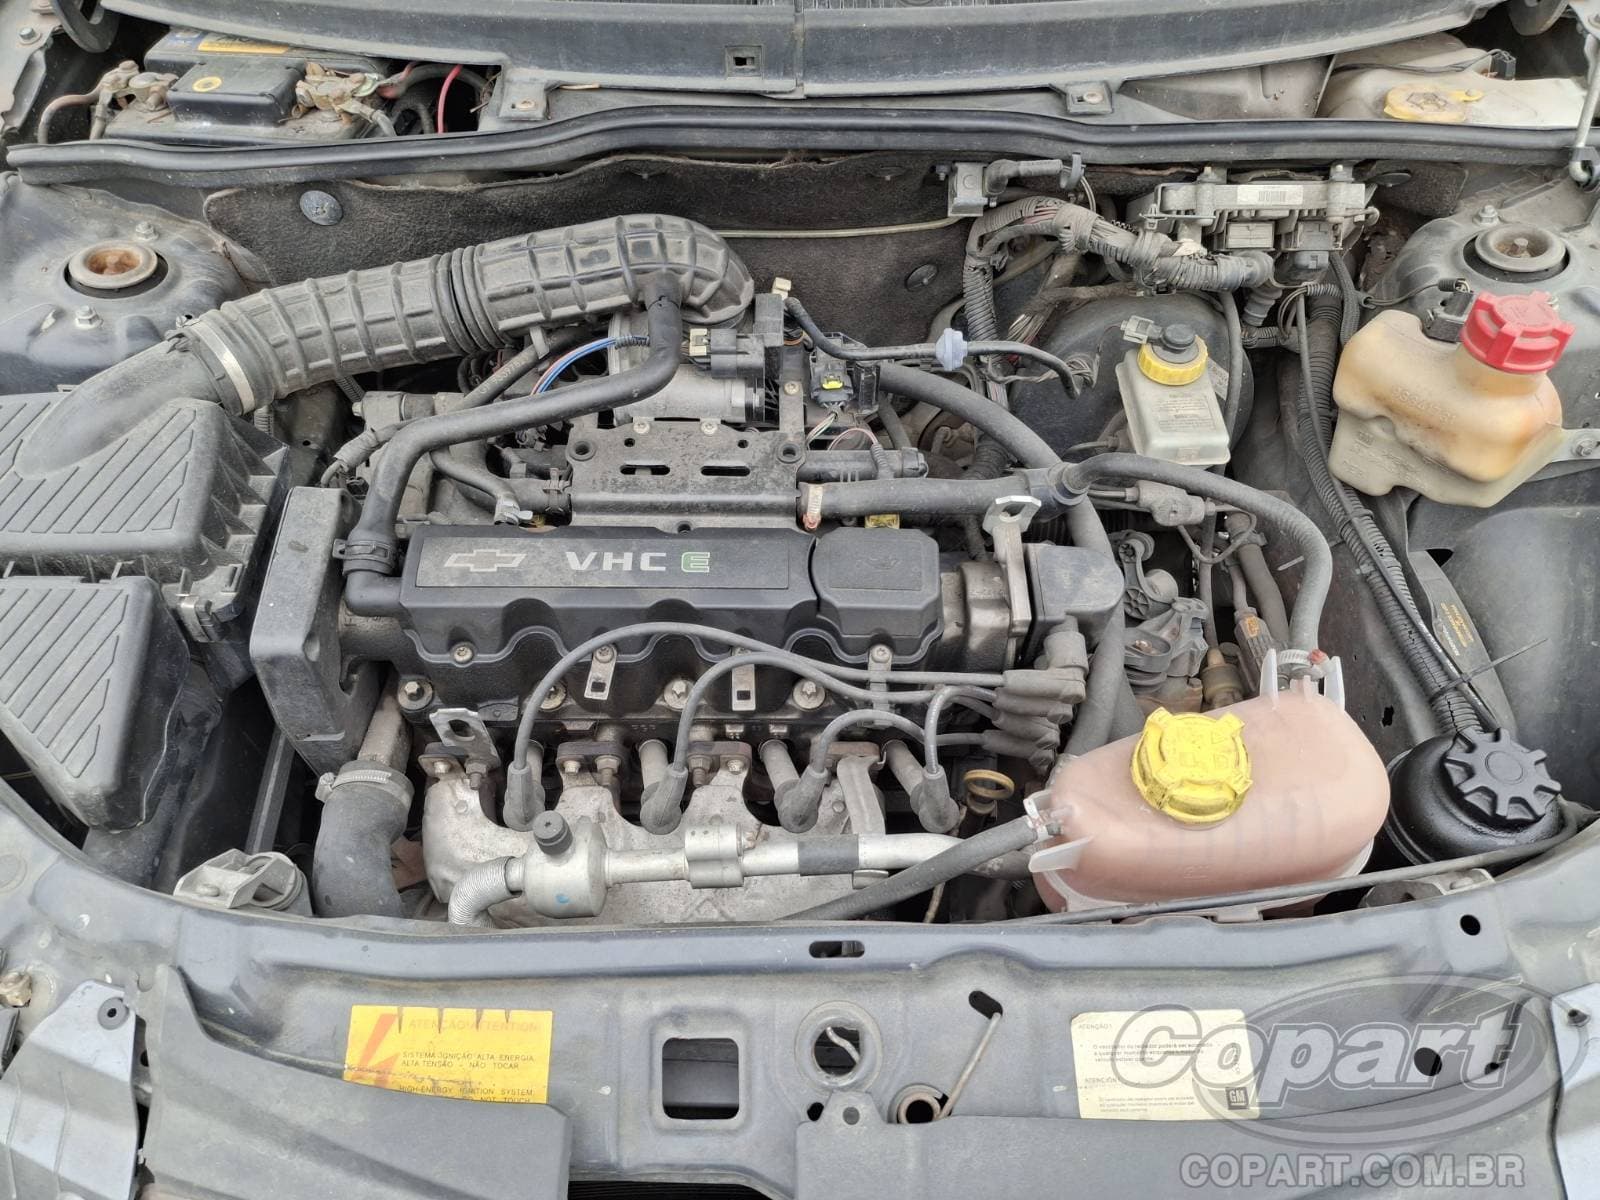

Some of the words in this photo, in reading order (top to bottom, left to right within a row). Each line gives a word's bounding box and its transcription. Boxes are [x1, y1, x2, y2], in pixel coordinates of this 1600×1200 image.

[565, 551, 667, 572] VHC
[680, 551, 711, 573] E
[402, 1051, 435, 1060] SISTEMA
[477, 1053, 495, 1061] ALTA
[402, 1059, 419, 1067] ALTA
[423, 1060, 454, 1069] TENSÃO
[469, 1061, 486, 1069] NÃO
[493, 1062, 519, 1070] TOCAR
[501, 1088, 533, 1096] SYSTEM
[1228, 1089, 1246, 1104] GM
